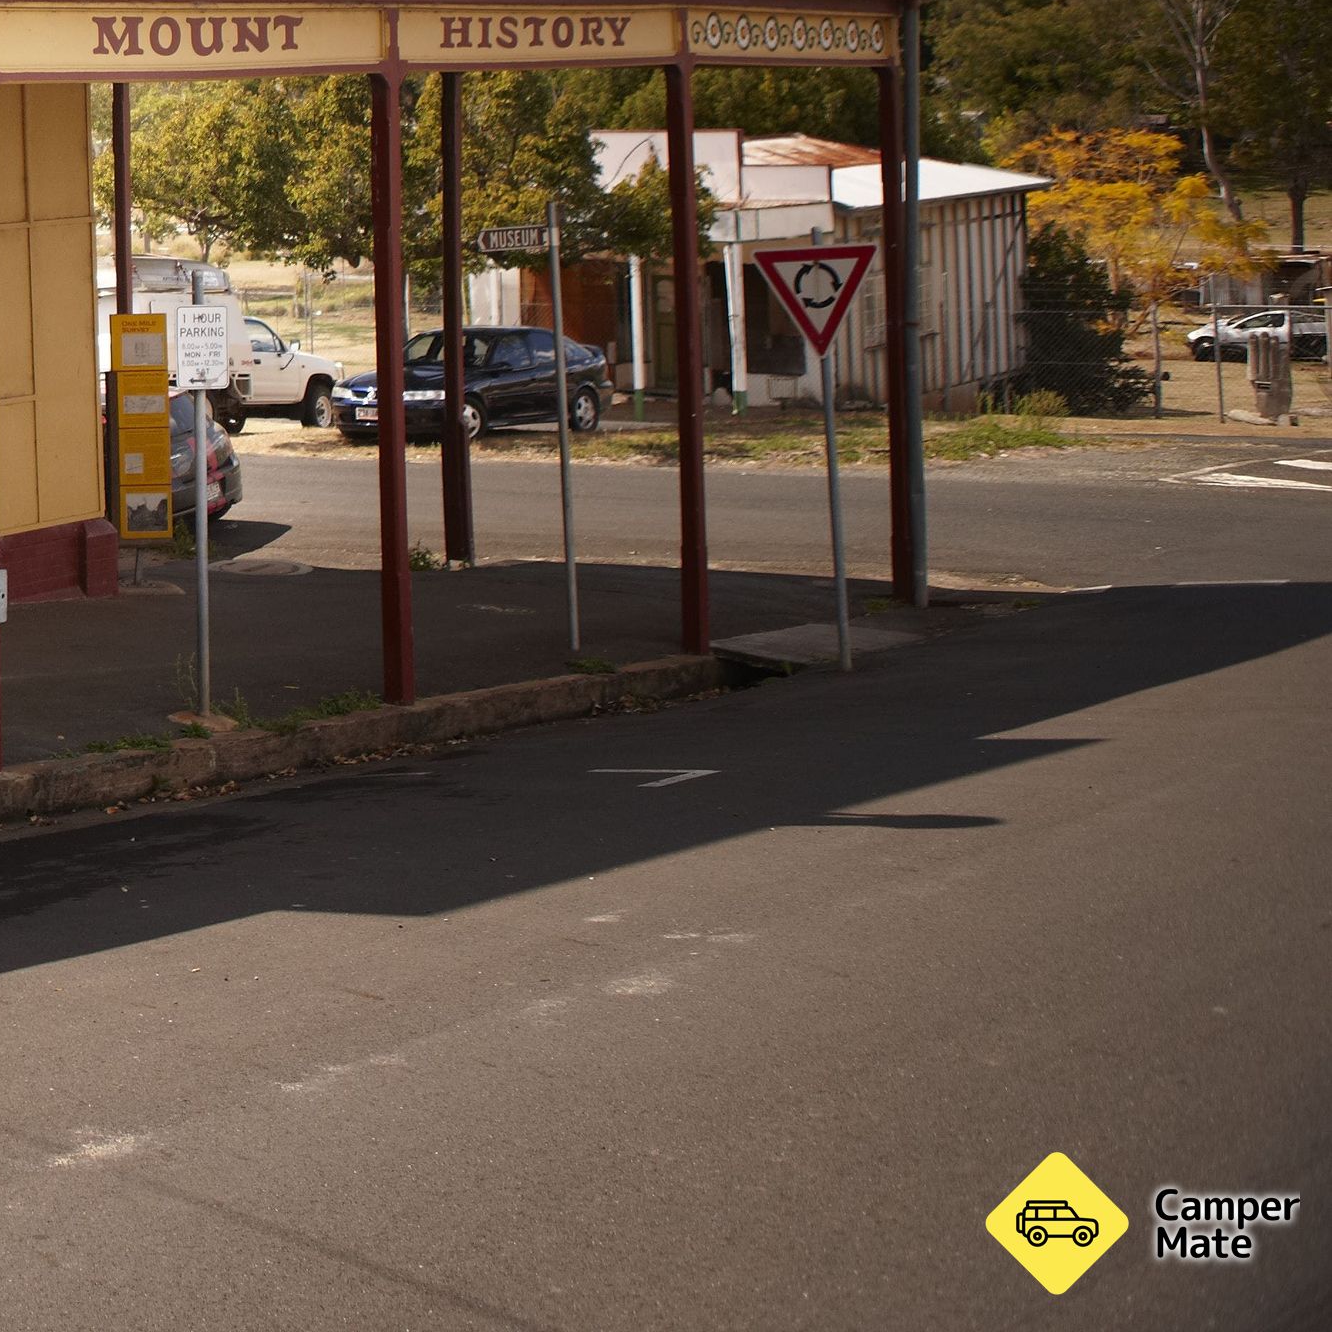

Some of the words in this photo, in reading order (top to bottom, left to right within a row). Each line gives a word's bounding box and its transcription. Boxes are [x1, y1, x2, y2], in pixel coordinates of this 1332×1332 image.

[92, 16, 304, 56] MOUNT
[440, 16, 632, 50] HISTORY
[489, 228, 539, 249] MUSEUM
[192, 313, 222, 324] HOUR
[179, 327, 225, 337] PARKING
